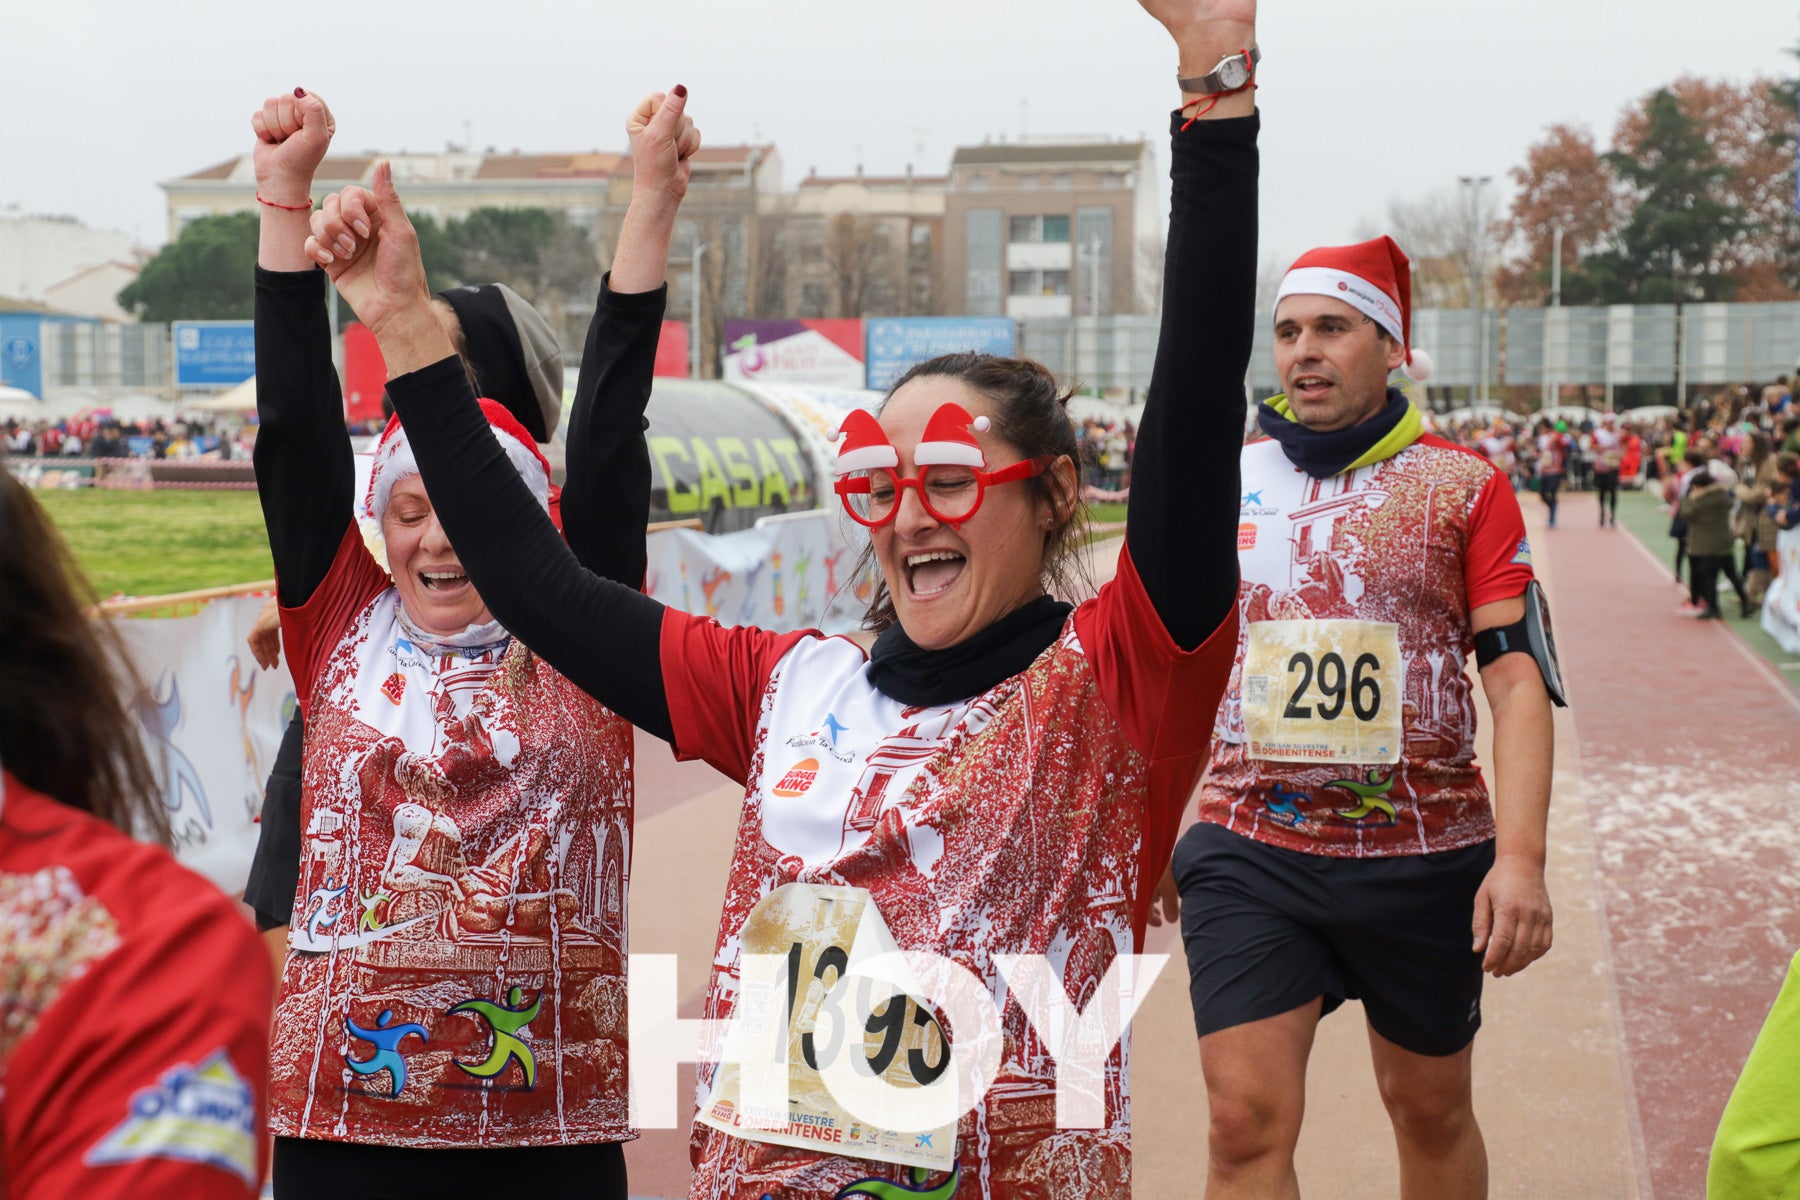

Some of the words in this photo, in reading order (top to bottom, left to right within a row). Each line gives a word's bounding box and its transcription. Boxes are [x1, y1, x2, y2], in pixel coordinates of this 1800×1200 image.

[1237, 537, 1256, 545] ING
[1283, 652, 1381, 722] 296
[1262, 747, 1336, 758] DOMBENITENSE
[785, 770, 817, 782] BURGER
[775, 778, 813, 792] KING
[711, 1109, 732, 1120] KING
[783, 1112, 835, 1128] SILVESTRE
[733, 1113, 842, 1143] DOMBENITENSE
